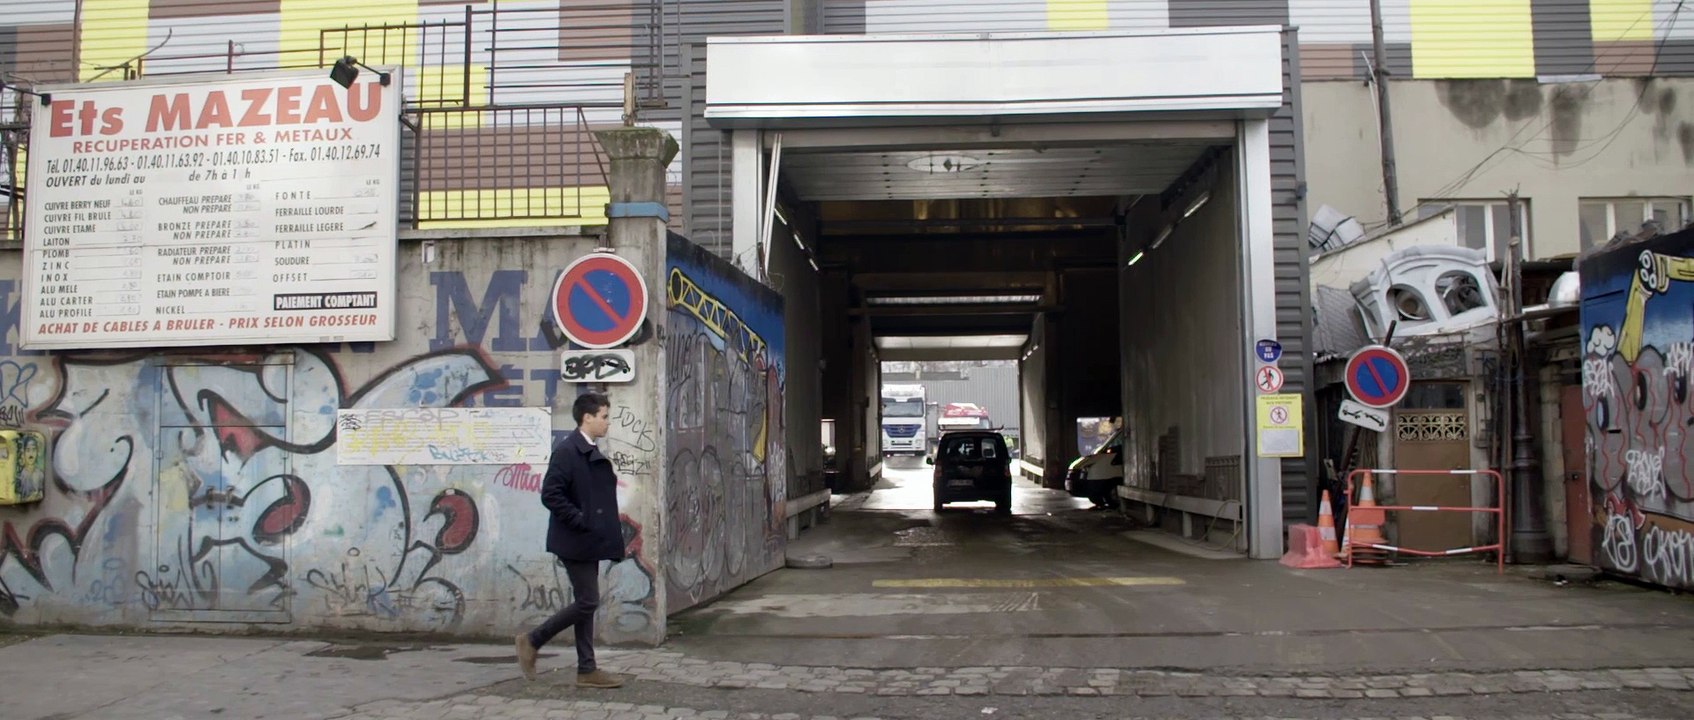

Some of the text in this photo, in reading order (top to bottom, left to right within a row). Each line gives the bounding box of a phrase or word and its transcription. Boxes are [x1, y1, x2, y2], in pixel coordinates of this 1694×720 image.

[50, 82, 382, 137] Ets MAZEAU
[73, 127, 352, 154] RECUPERATION FER & METAUX
[62, 156, 129, 173] 01.40.11.96.63
[137, 152, 203, 170] 01.40.11.63.92
[213, 149, 279, 166] 01.40.10.83.51
[289, 148, 307, 162] Fax.
[310, 144, 381, 162] 01.40.12.69.74
[46, 175, 87, 188] OUVERT
[90, 174, 102, 185] du
[105, 173, 130, 185] lundi
[133, 175, 146, 184] au
[189, 170, 201, 182] de
[205, 169, 218, 181] 7h
[221, 169, 228, 180] à
[159, 196, 199, 205] CHAUFFEAU
[201, 194, 232, 203] PREPARE
[276, 191, 311, 200] FONTE
[44, 201, 69, 211] CUIVRE
[71, 201, 92, 210] BERRY
[94, 200, 111, 208] NEUF
[183, 204, 232, 214] NON PREPARE
[275, 206, 344, 217] FERRAILLE LOURDE
[44, 214, 71, 223] CUIVRE
[74, 213, 85, 221] FIL
[88, 212, 111, 221] BRULE
[44, 225, 96, 235] CUIVRE ETAME
[158, 222, 191, 231] BRONZE
[195, 220, 231, 229] PREPARE
[275, 223, 344, 233] FERRAILLE LEGERE
[173, 231, 191, 240] NON
[195, 230, 231, 239] PREPARE
[43, 238, 70, 246] LAITON
[275, 240, 311, 249] PLATIN
[43, 250, 70, 258] PLOMB
[158, 247, 196, 256] RADIATEUR
[200, 246, 231, 255] PREPARE
[173, 257, 191, 265] NON
[194, 256, 231, 264] PREPARE
[275, 257, 309, 266] SOUDURE
[43, 262, 70, 271] ZINC
[41, 273, 68, 282] INOX
[158, 274, 181, 282] ETAIN
[185, 272, 231, 280] COMPTOIR
[273, 273, 308, 282] OFFSET
[41, 285, 78, 294] ALU MELE
[157, 290, 176, 298] ETAIN
[178, 289, 202, 297] POMPE
[212, 288, 230, 296] BIERE
[40, 297, 93, 306] ALU CARTER
[276, 294, 375, 309] PAIEMENT COMPTANT
[40, 309, 92, 318] ALU PROFILE
[156, 306, 185, 314] NICKEL
[38, 323, 79, 335] ACHAT
[82, 322, 98, 333] DE
[103, 321, 149, 332] CABLES
[153, 320, 161, 331] A
[166, 319, 215, 331] BRULER
[229, 317, 259, 329] PRIX
[264, 316, 304, 328] SELON
[309, 314, 377, 327] GROSSEUR
